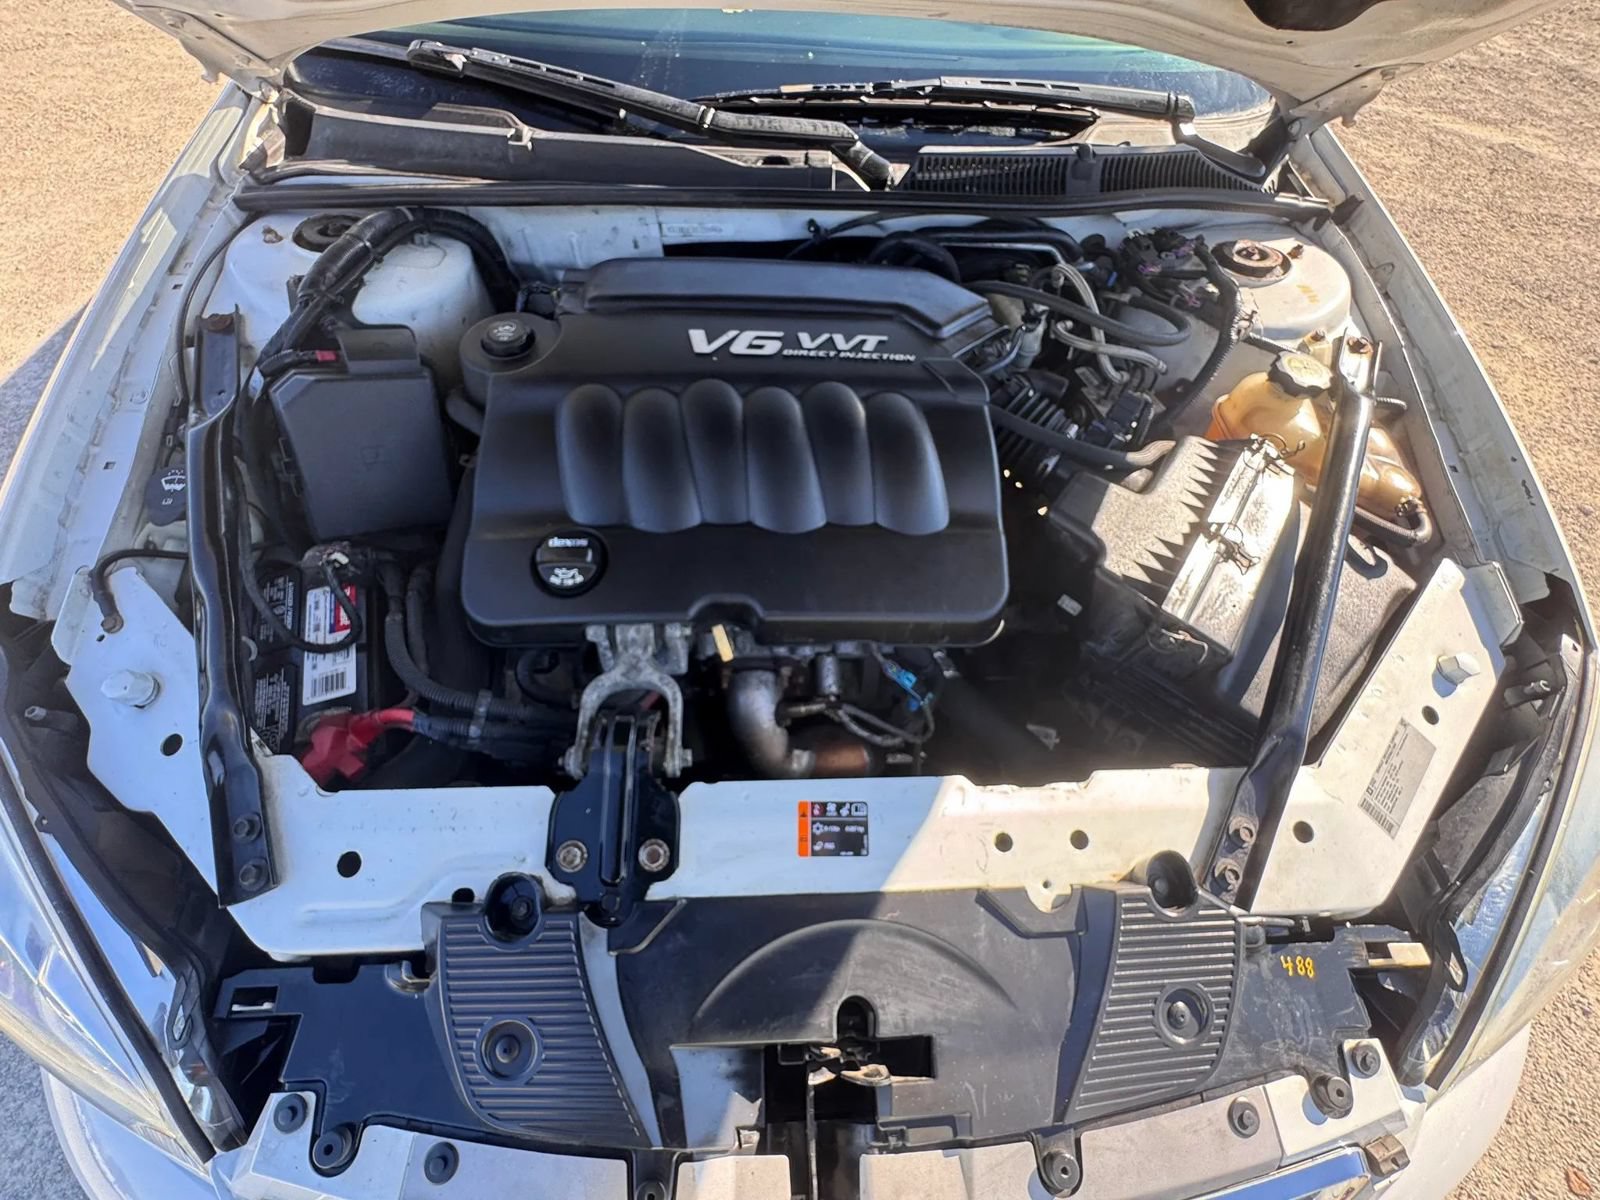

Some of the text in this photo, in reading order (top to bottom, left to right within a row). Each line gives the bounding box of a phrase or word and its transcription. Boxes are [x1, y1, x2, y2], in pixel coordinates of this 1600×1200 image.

[687, 329, 889, 355] V6 VVT
[782, 349, 917, 361] DIRECT INJECTION
[1280, 955, 1315, 978] 488
